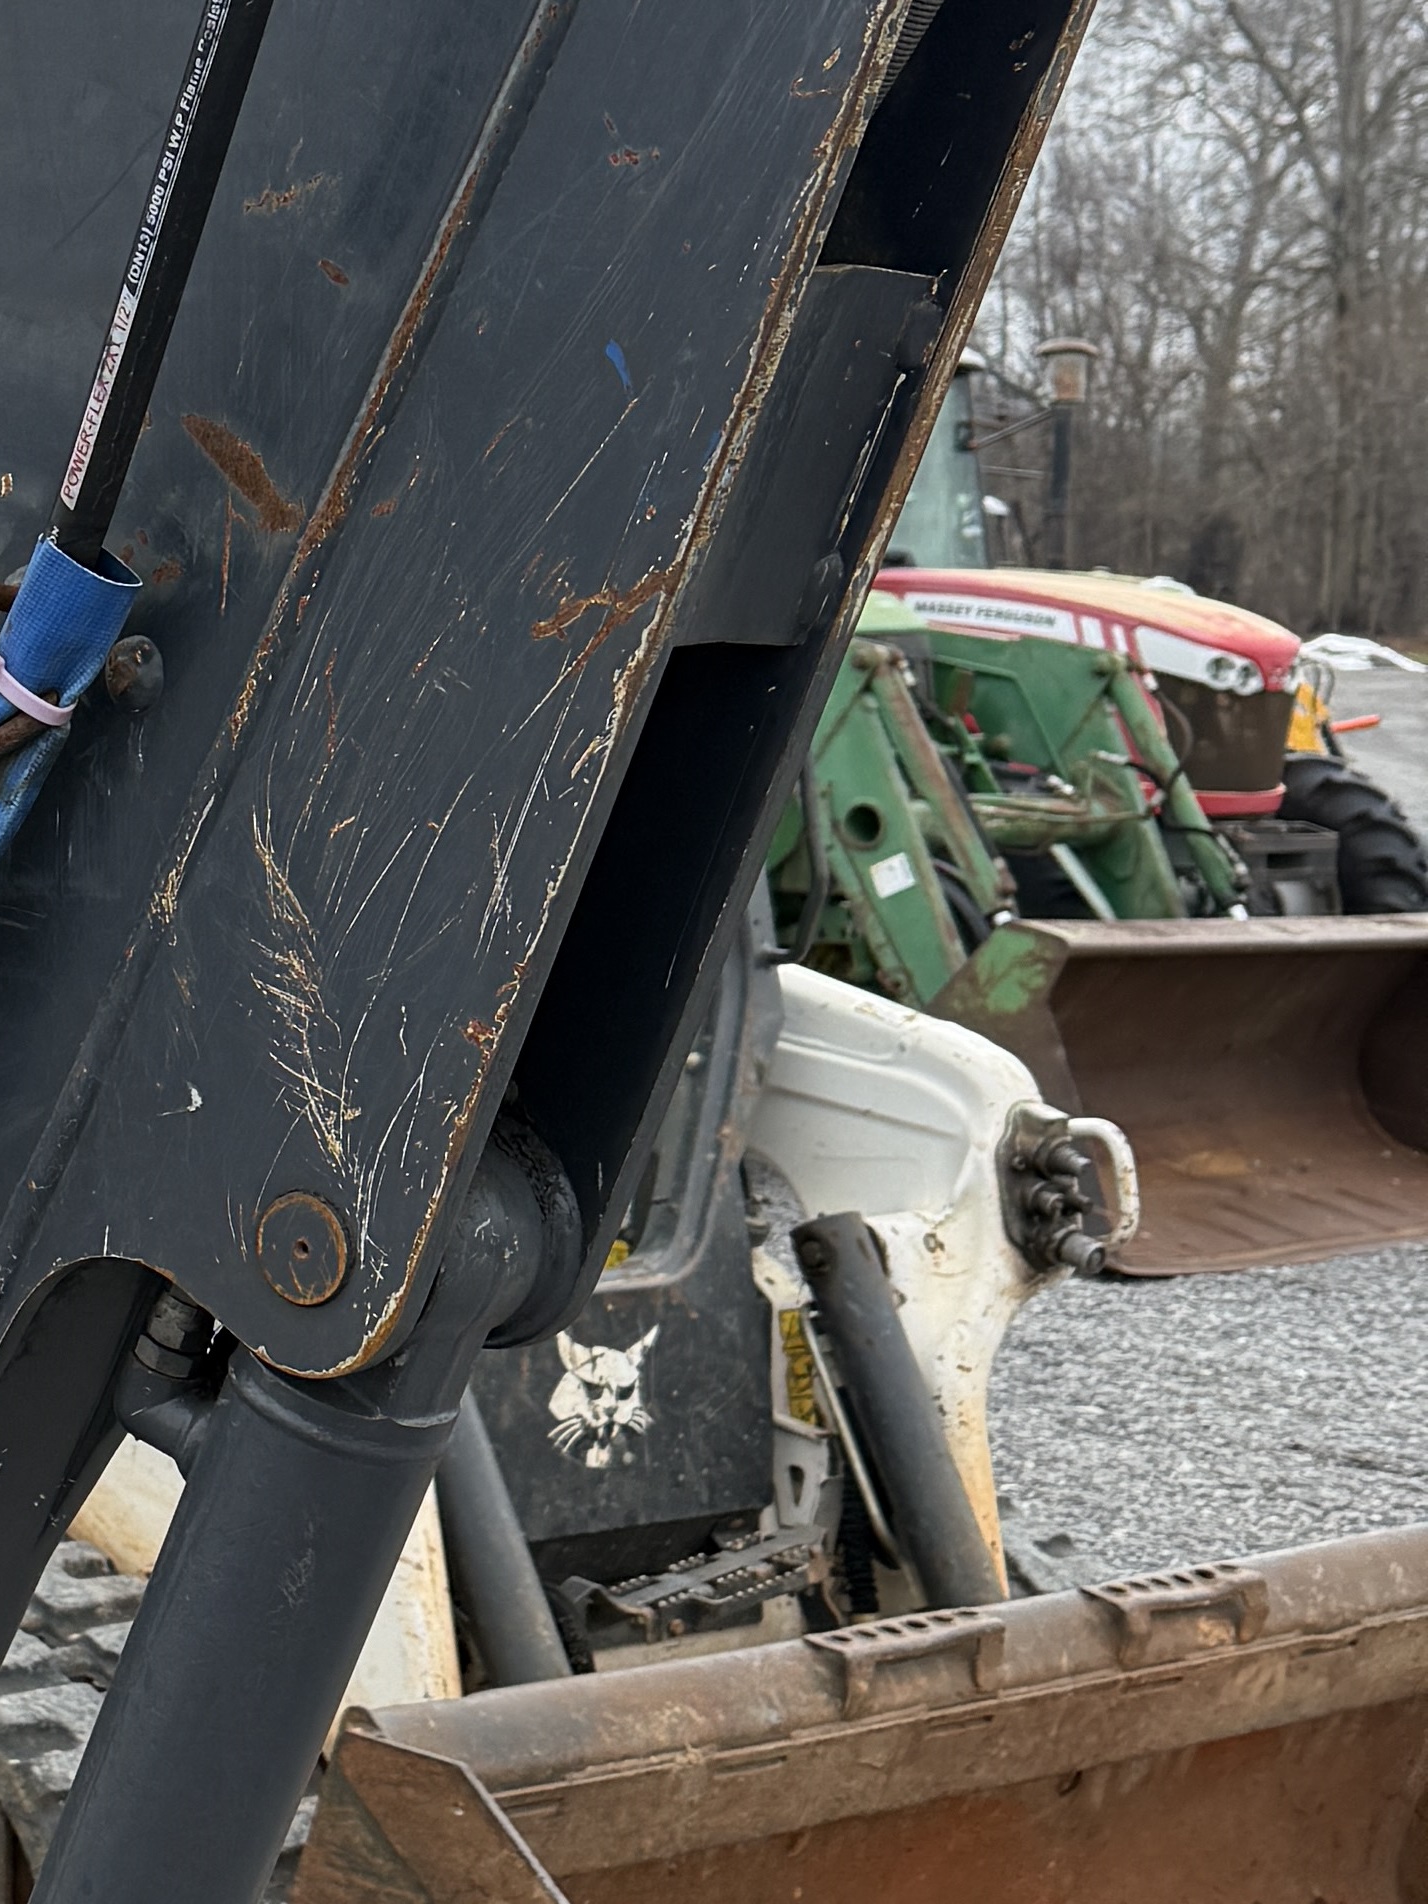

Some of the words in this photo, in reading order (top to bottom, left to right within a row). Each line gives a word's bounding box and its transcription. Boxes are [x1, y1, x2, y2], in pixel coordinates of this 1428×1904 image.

[63, 377, 110, 500] POWER-FLEX
[127, 226, 155, 284] (DN13)
[145, 187, 166, 226] 5000
[158, 151, 176, 183] PSI
[168, 113, 186, 149] W.P
[179, 57, 205, 112] Flame
